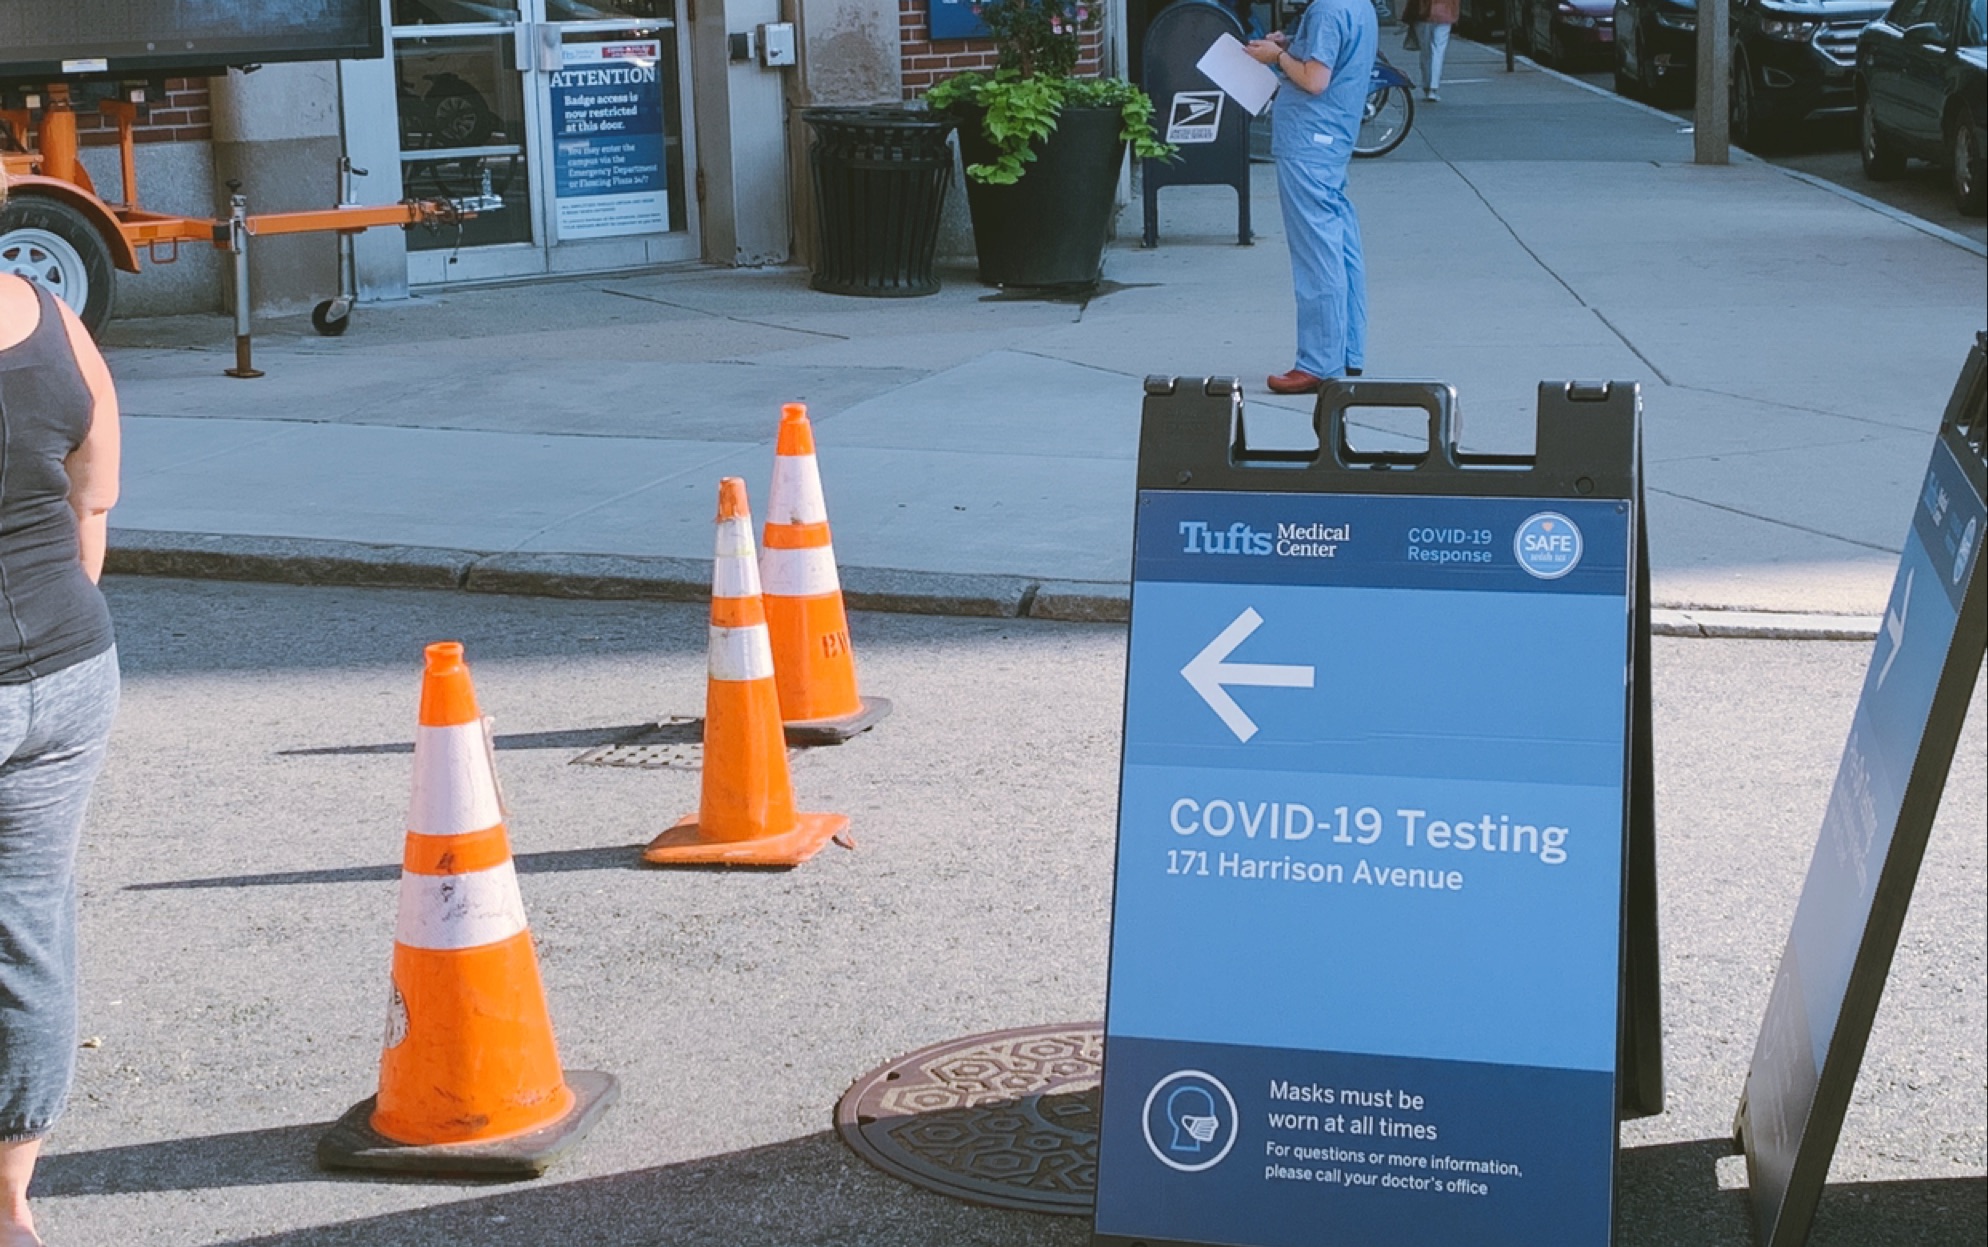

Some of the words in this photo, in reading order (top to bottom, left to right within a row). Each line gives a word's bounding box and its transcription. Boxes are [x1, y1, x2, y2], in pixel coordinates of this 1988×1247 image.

[550, 67, 656, 88] ATTENTION
[564, 94, 595, 107] Badge
[597, 94, 628, 104] access
[629, 91, 639, 102] is
[565, 110, 587, 119] now
[589, 105, 638, 117] restricted
[566, 124, 576, 132] at
[578, 121, 598, 131] this
[1179, 521, 1273, 556] Tufts
[1277, 523, 1350, 542] Medical
[1408, 527, 1492, 545] COVID-19
[1276, 539, 1337, 558] Center
[1525, 534, 1572, 552] SAFE
[1408, 545, 1492, 565] Response
[1169, 798, 1383, 845] COVID-19
[1396, 808, 1570, 865] Testing
[1166, 849, 1210, 876] 171
[1218, 852, 1344, 884] Harrison
[1352, 860, 1464, 891] Avenue
[1269, 1079, 1335, 1104] Masks
[1340, 1088, 1393, 1108] must
[1399, 1090, 1425, 1111] be
[1268, 1112, 1319, 1131] worn
[1324, 1113, 1345, 1134] at
[1349, 1115, 1374, 1136] all
[1379, 1118, 1438, 1141] times
[1266, 1141, 1291, 1157] For
[1293, 1147, 1366, 1164] questions
[1368, 1153, 1385, 1165] or
[1388, 1155, 1428, 1169] more
[1431, 1155, 1523, 1178] information,
[1265, 1163, 1313, 1181] please
[1315, 1168, 1342, 1183] call
[1344, 1173, 1378, 1187] your
[1381, 1172, 1443, 1192] doctor's
[1446, 1178, 1489, 1196] office
